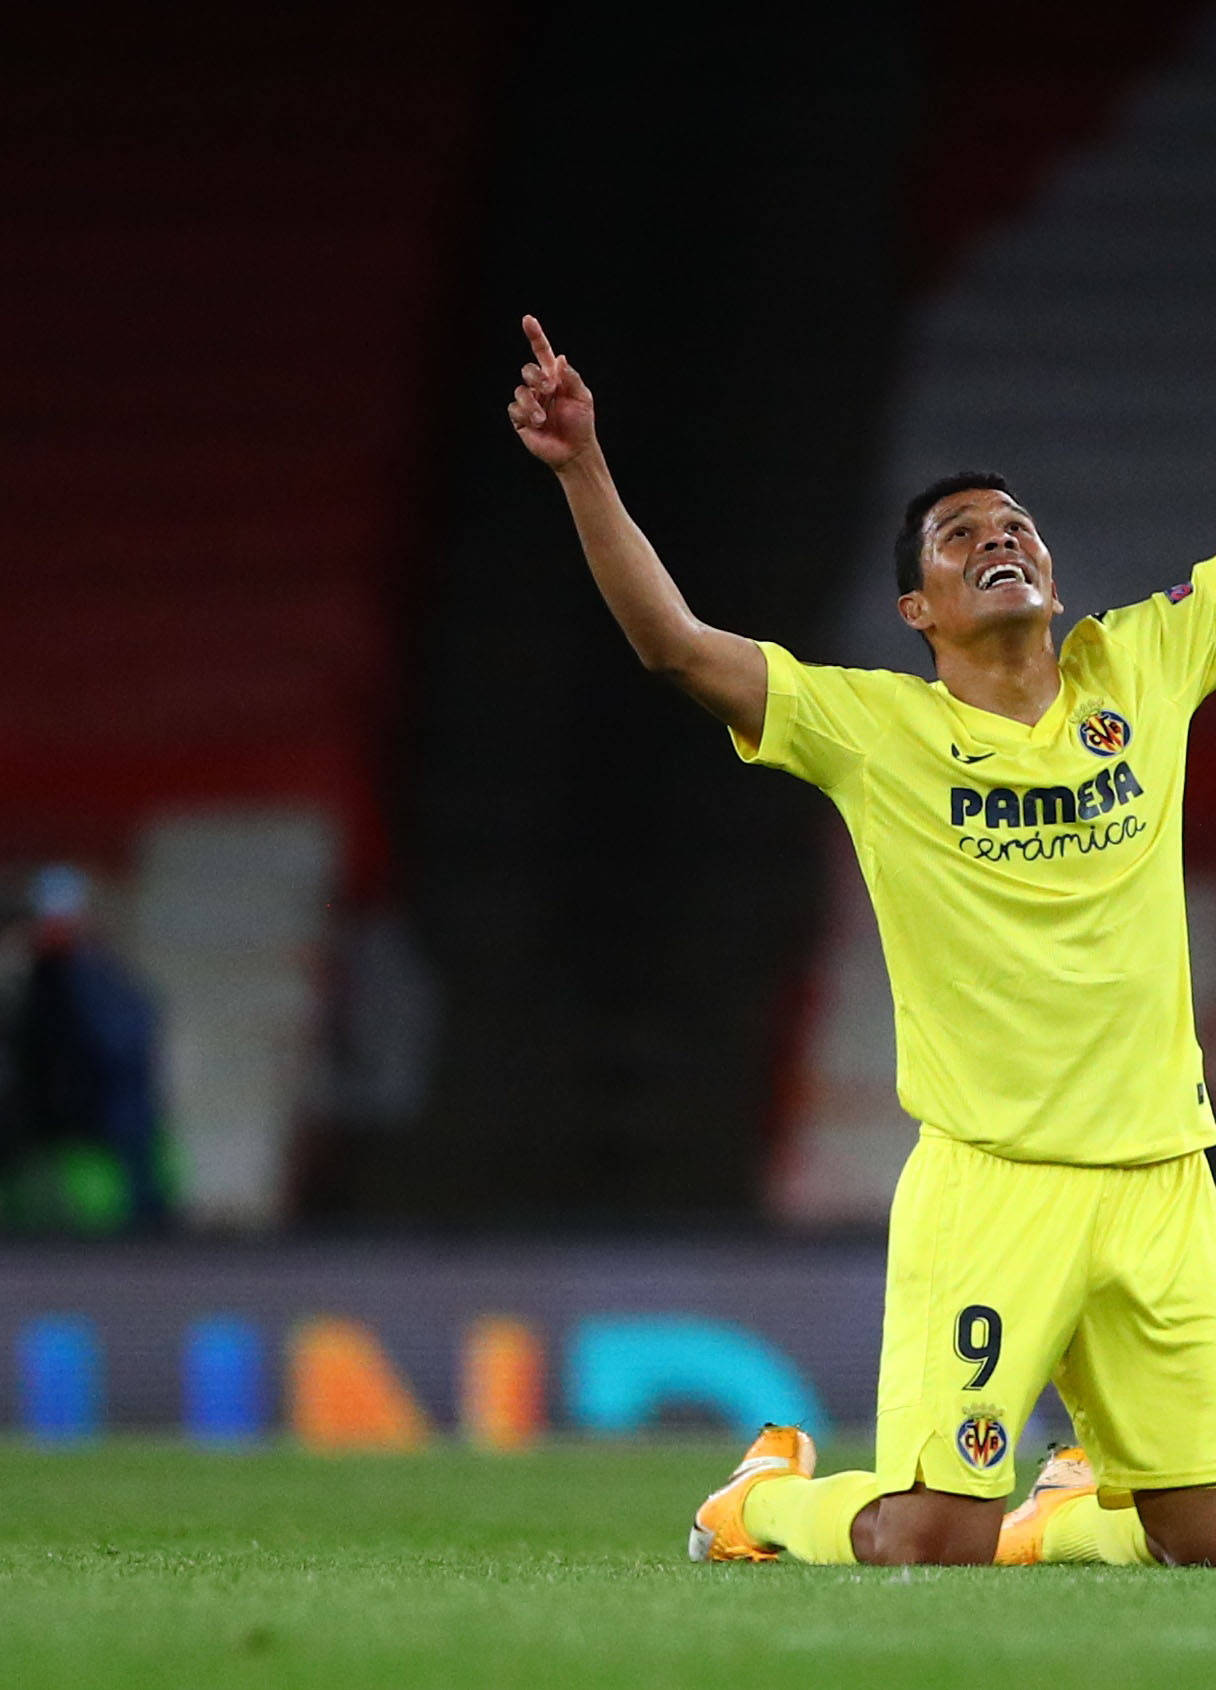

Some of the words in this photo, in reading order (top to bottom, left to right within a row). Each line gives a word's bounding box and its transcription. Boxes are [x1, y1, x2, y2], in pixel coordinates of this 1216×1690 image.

[950, 761, 1144, 828] PAMESA
[959, 814, 1147, 862] cerámica
[953, 1304, 1003, 1391] 9
